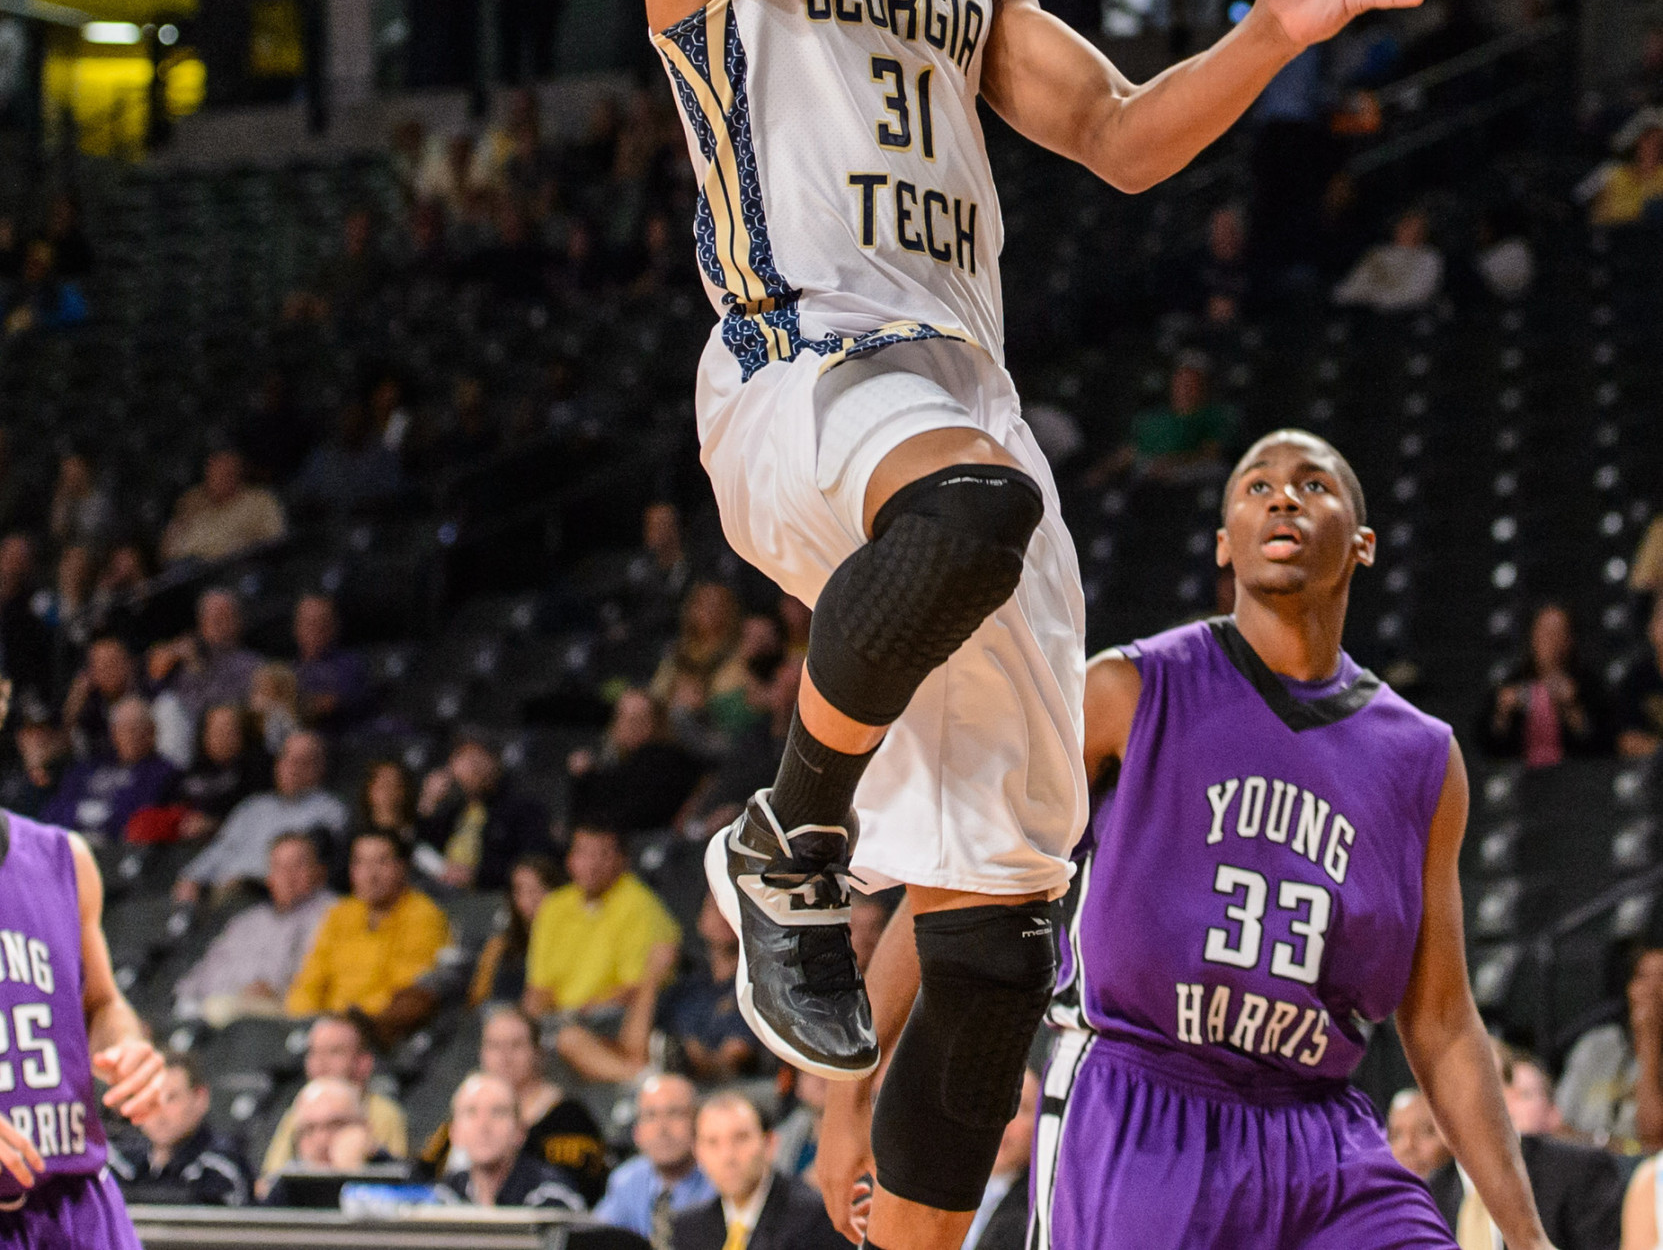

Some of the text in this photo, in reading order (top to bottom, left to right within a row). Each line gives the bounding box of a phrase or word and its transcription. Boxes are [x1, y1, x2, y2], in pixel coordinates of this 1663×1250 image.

[869, 53, 936, 163] 31
[846, 171, 978, 277] TECH
[1206, 775, 1356, 884] YOUNG
[0, 929, 54, 994] NG
[1204, 863, 1332, 985] 33
[1176, 982, 1331, 1066] HARRIS
